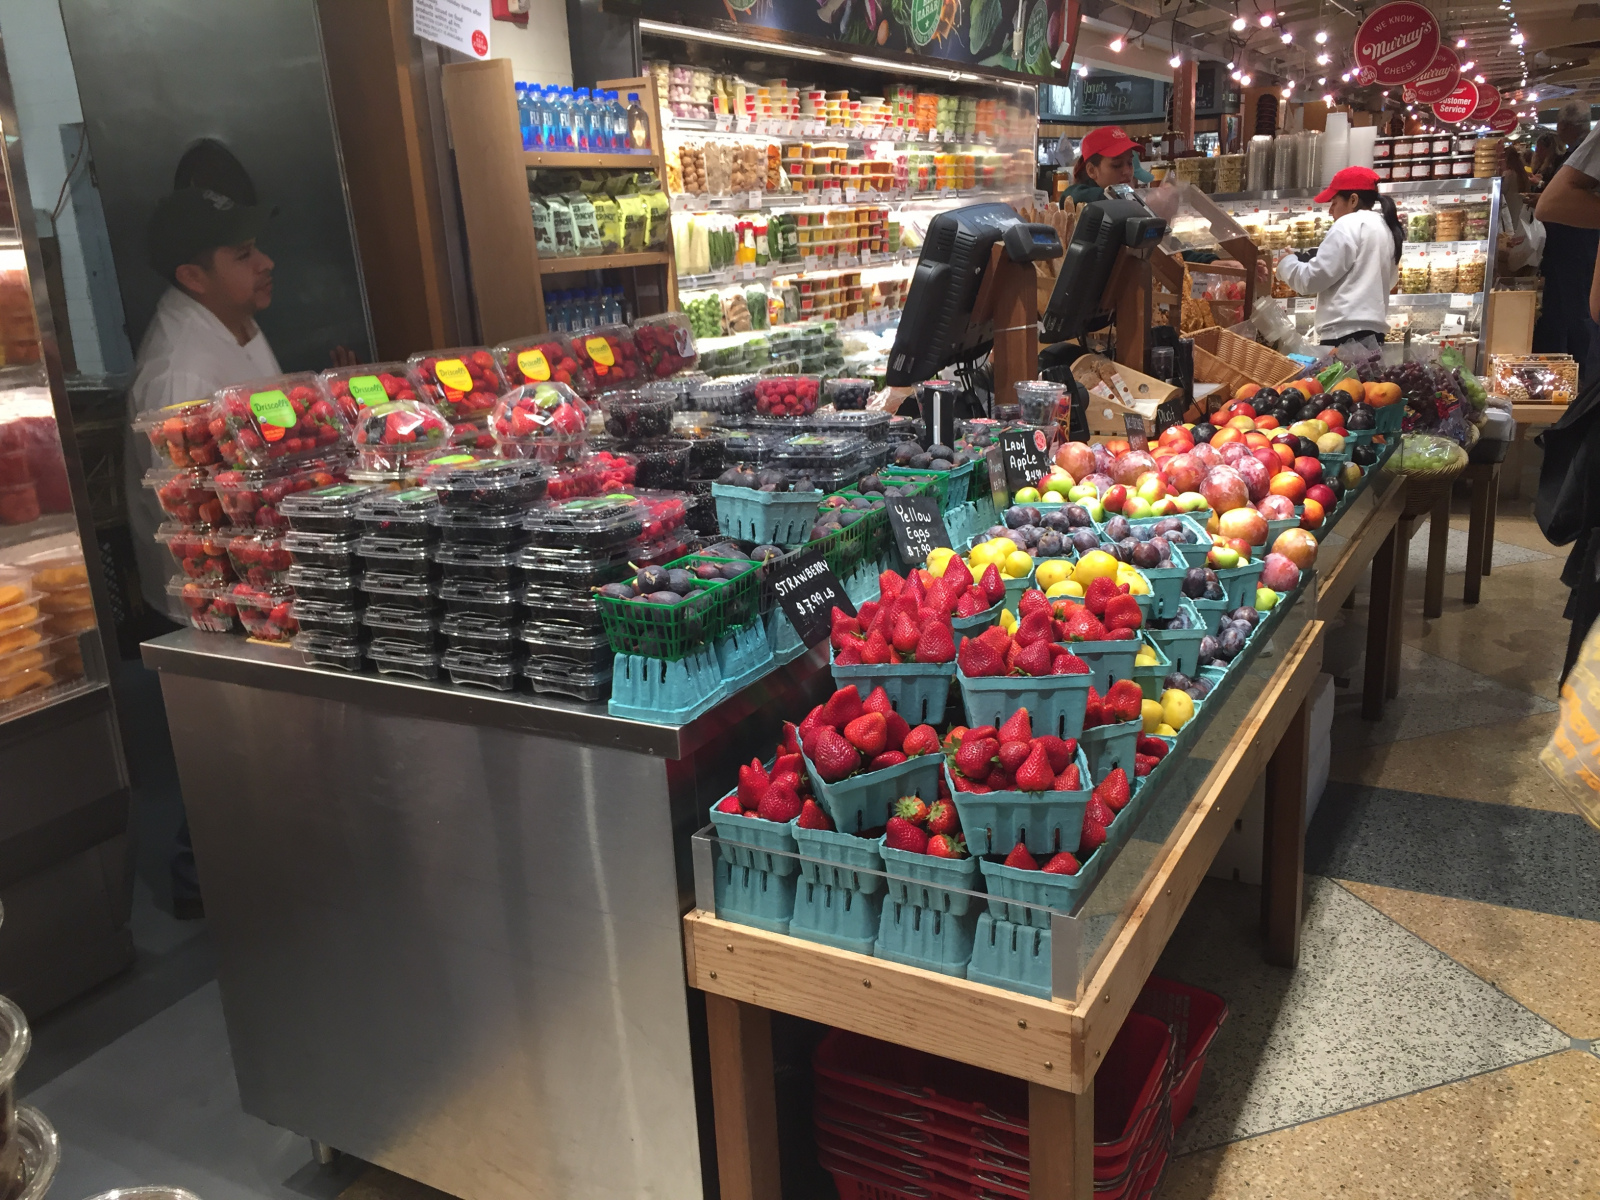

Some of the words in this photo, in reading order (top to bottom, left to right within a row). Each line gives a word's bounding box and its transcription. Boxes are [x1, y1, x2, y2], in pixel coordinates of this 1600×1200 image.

[1374, 20, 1388, 33] WE
[1389, 14, 1415, 25] KNOW
[1362, 20, 1432, 65] Murray's
[1384, 59, 1417, 75] CHEESE
[1418, 87, 1441, 97] CHEESE
[1439, 96, 1472, 106] ustomer
[1439, 104, 1467, 114] Service
[438, 367, 467, 377] Driscoll's
[353, 384, 382, 394] Driscoll's
[254, 398, 289, 412] Driscoll's
[894, 504, 932, 525] Yellow
[905, 526, 931, 544] Eggs
[906, 543, 932, 558] $7.99
[775, 559, 830, 597] STRAWBERRY
[795, 591, 825, 615] $7.99
[824, 586, 836, 600] LB
